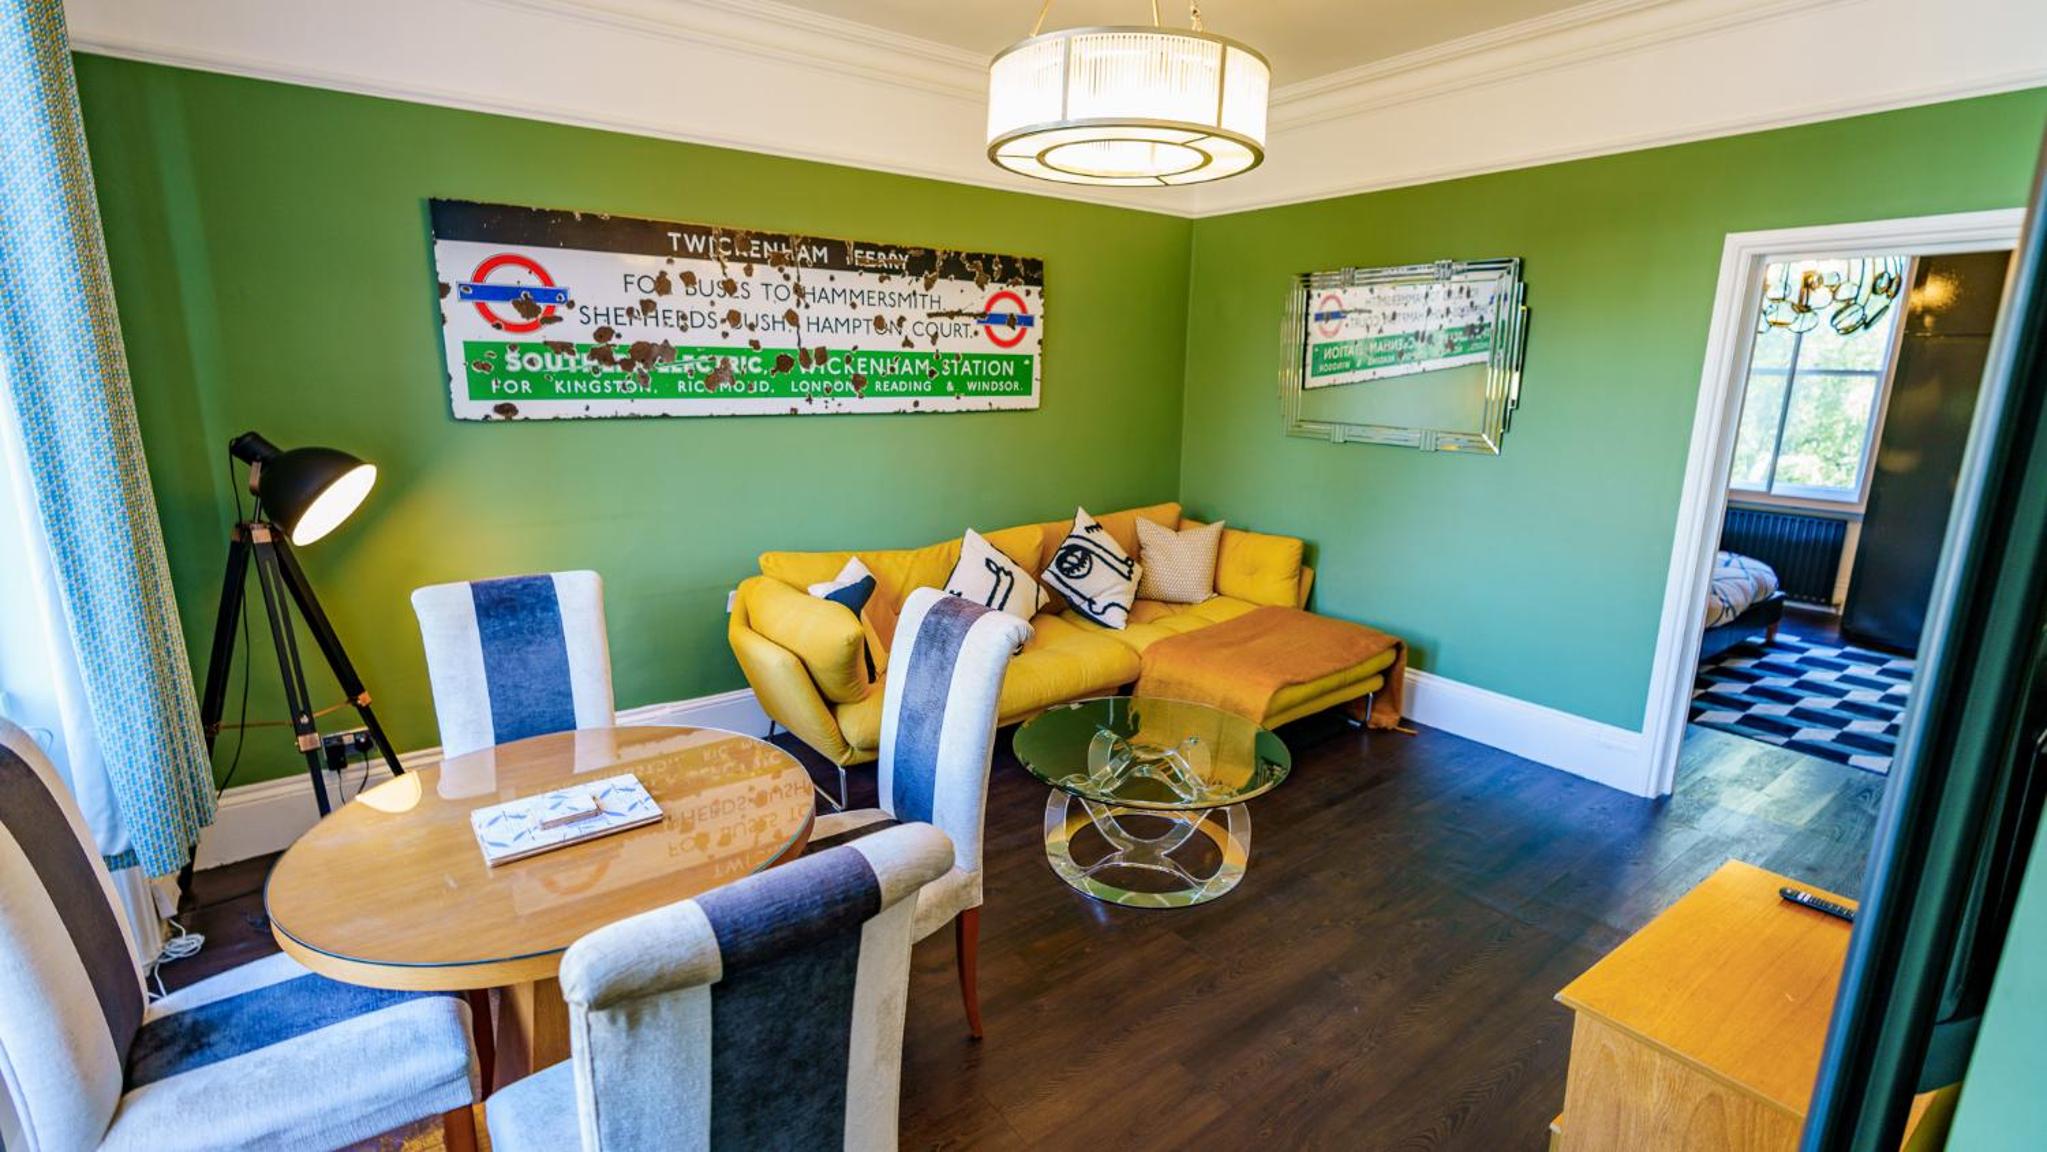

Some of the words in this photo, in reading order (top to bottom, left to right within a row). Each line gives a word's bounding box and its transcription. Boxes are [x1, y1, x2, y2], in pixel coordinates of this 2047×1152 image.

[624, 274, 672, 296] FO
[686, 279, 751, 300] BUSS
[761, 283, 791, 301] TO
[729, 311, 793, 332] USH.
[912, 321, 973, 339] COURT.
[779, 356, 930, 376] WICKENHAM
[942, 359, 1014, 376] STATION
[492, 380, 532, 394] FOR
[678, 381, 775, 394] RICMOD.
[875, 381, 932, 392] READING
[946, 381, 954, 391] &
[967, 381, 1023, 392] WINDSOR.
